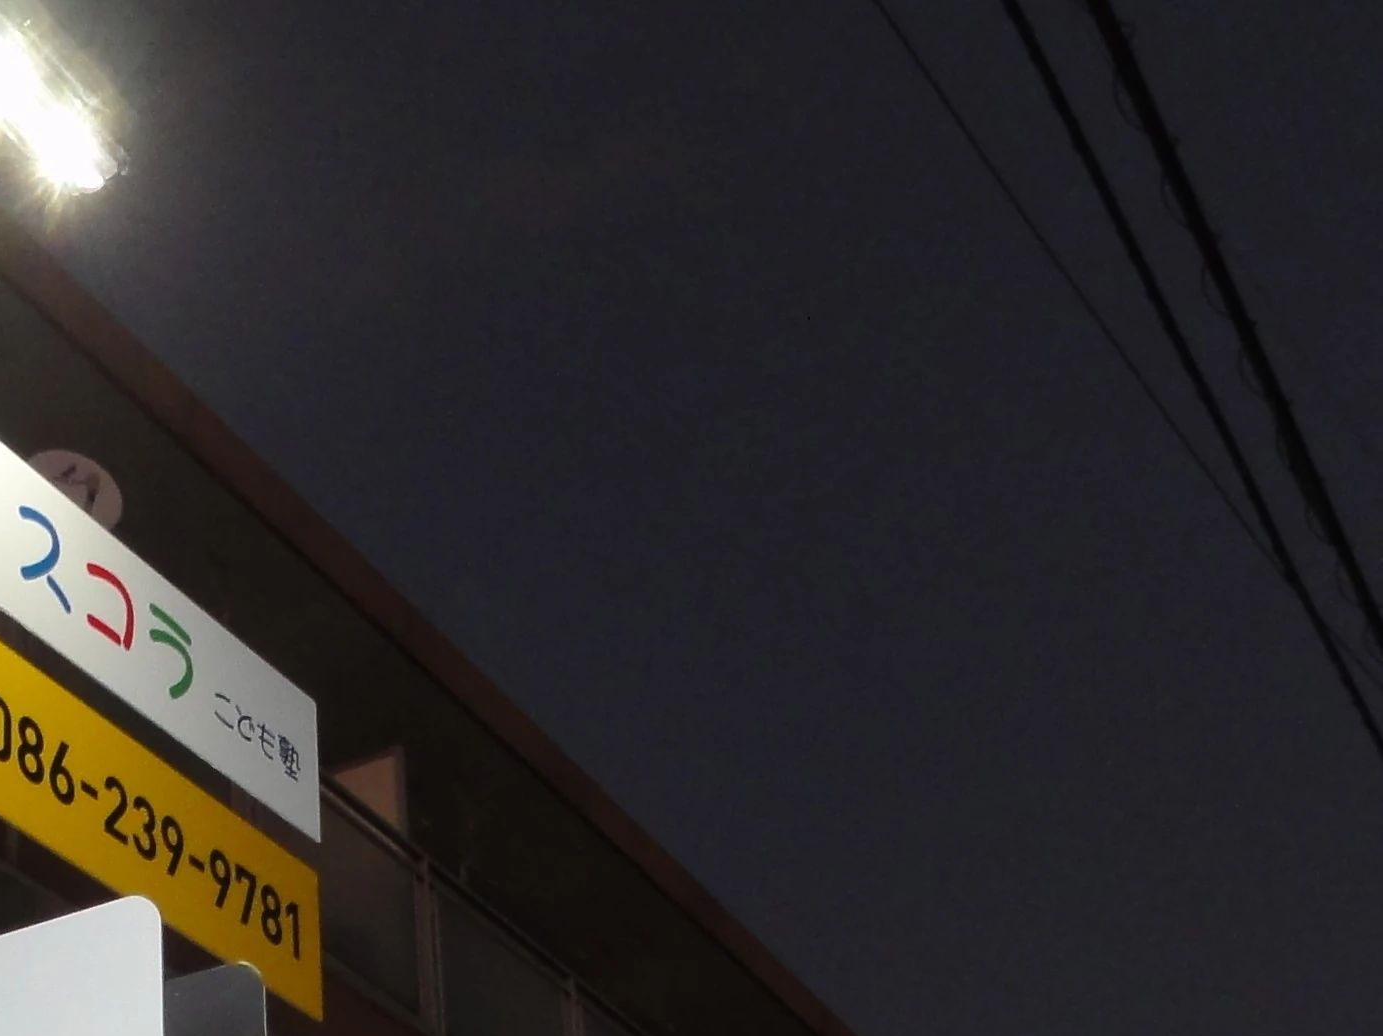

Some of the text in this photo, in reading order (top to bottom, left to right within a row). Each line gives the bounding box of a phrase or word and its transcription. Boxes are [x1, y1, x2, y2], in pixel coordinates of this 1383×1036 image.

[18, 505, 301, 781] スコラ こども塾
